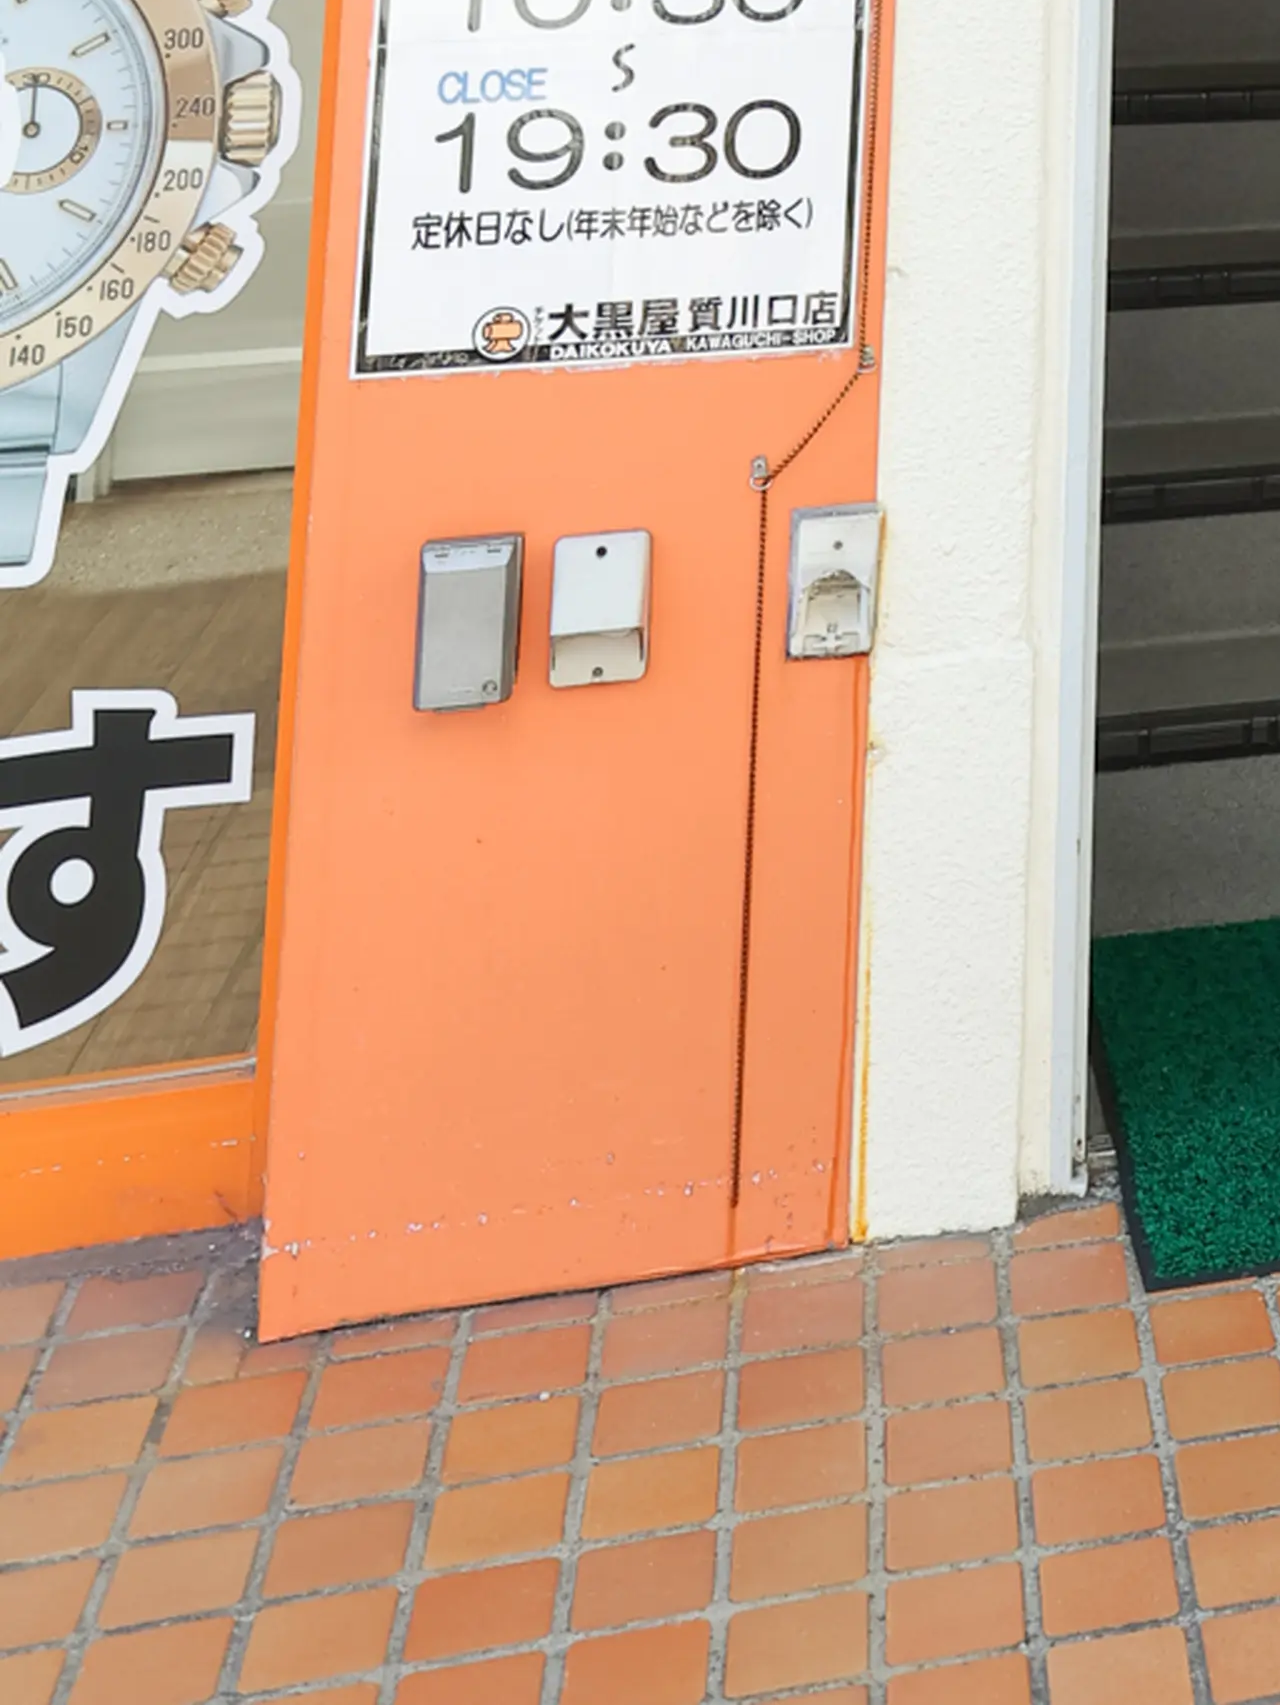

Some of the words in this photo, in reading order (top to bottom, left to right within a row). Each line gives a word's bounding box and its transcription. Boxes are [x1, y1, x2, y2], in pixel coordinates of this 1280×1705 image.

[164, 28, 204, 50] 300
[437, 67, 548, 104] CLOSE
[176, 97, 215, 119] 240
[436, 99, 802, 193] 19:30
[164, 168, 204, 190] 200
[135, 230, 171, 252] 180
[99, 278, 134, 300] 160
[55, 316, 93, 337] 150
[8, 344, 45, 367] 140
[551, 339, 672, 362] DAIKOKUYA
